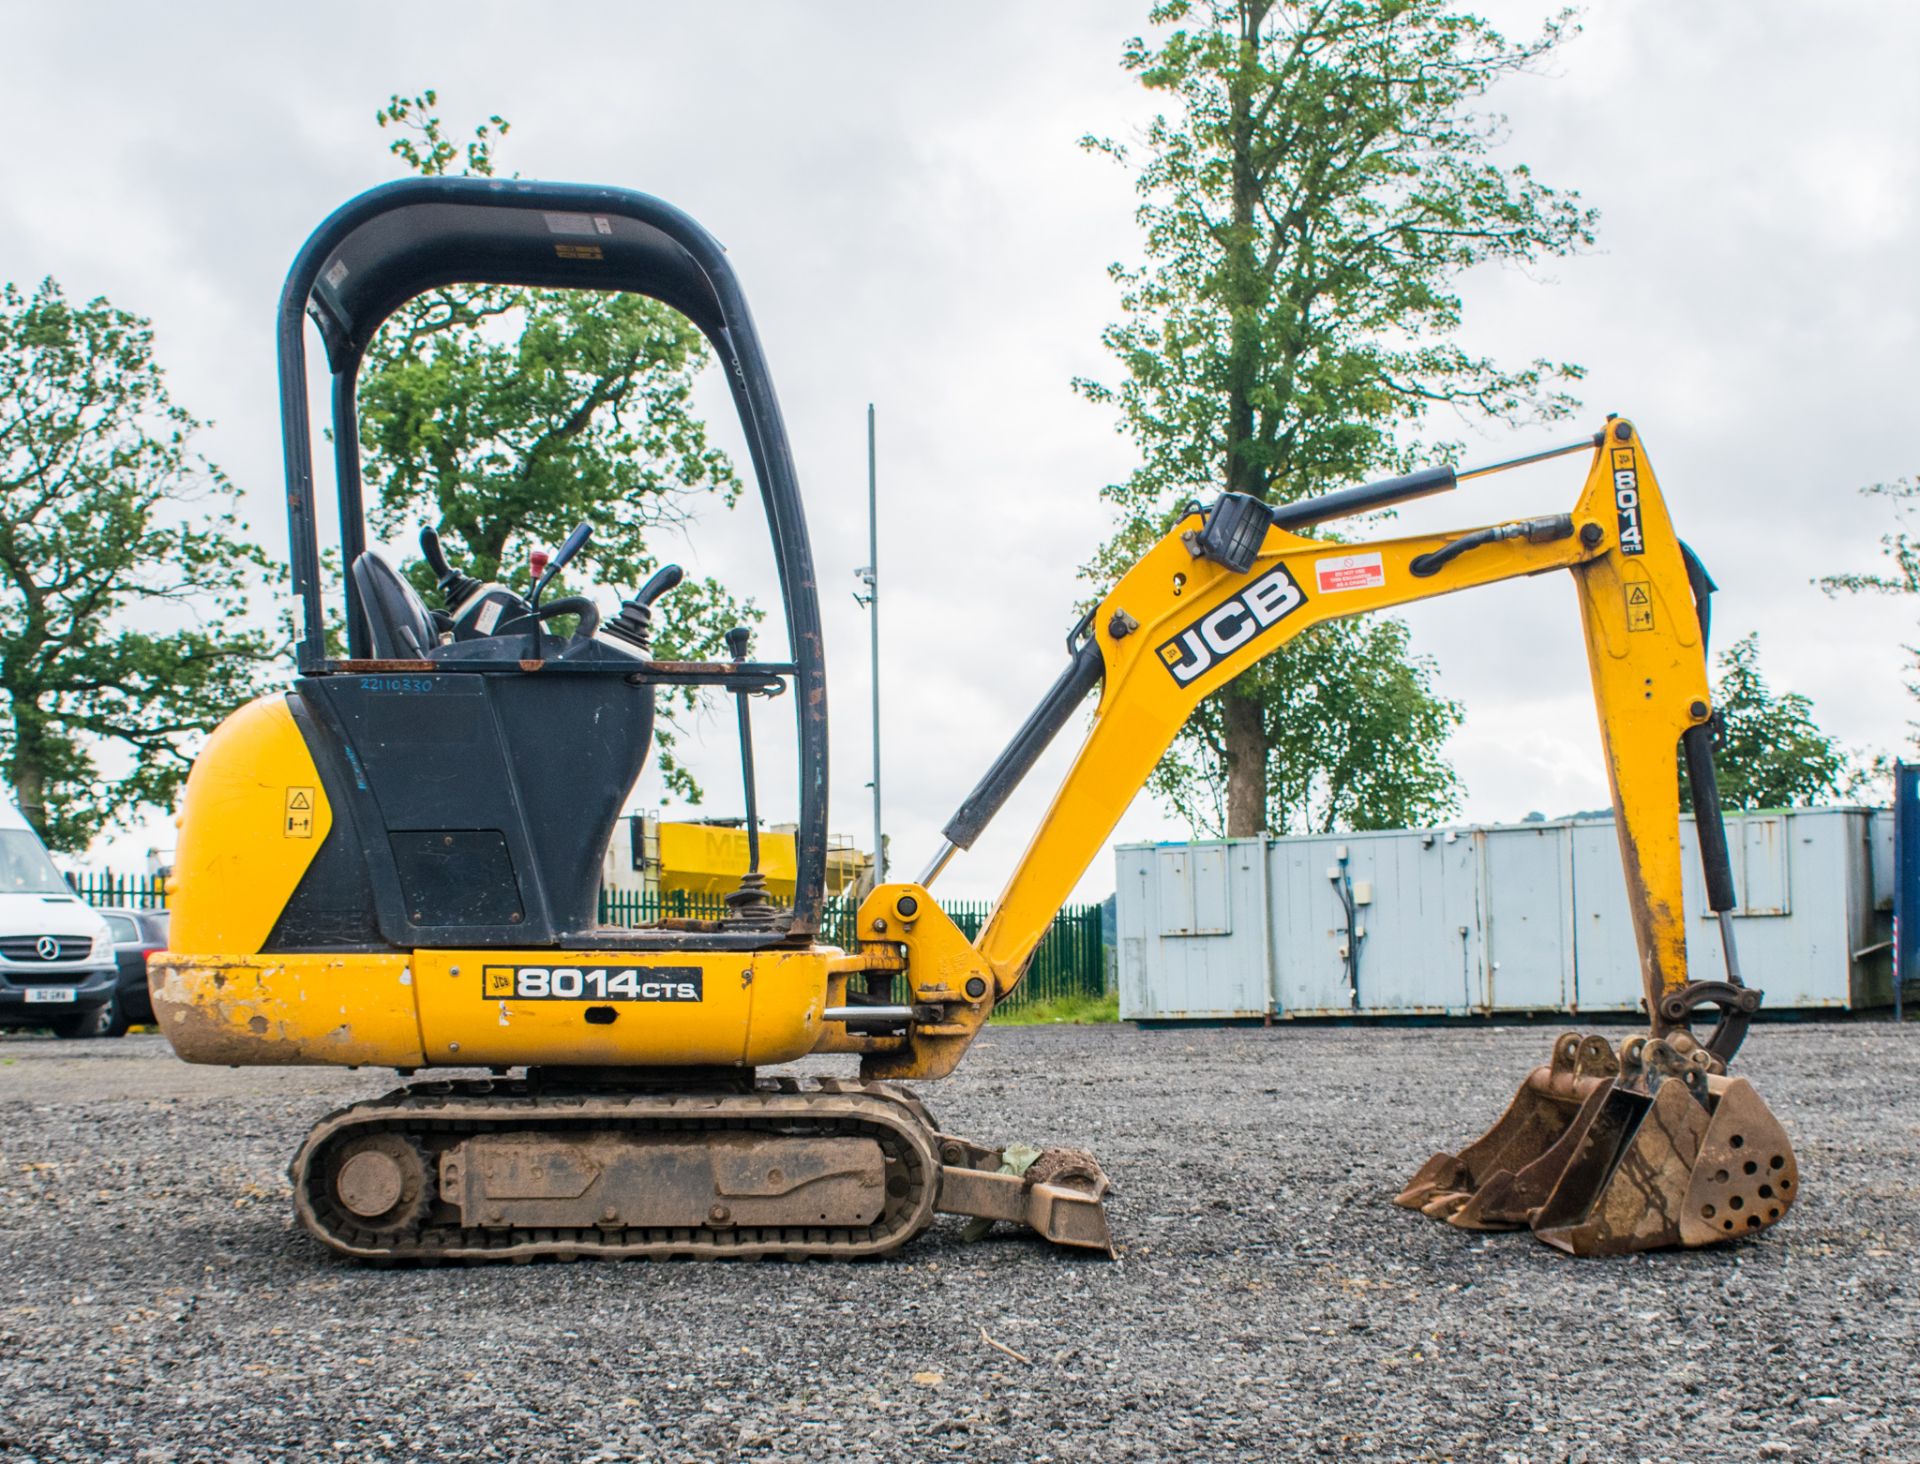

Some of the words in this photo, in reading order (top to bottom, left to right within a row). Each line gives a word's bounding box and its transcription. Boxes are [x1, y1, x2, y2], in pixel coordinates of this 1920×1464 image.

[1615, 471, 1642, 544] 8014
[1172, 571, 1301, 681] JCB
[360, 677, 433, 692] 22110330
